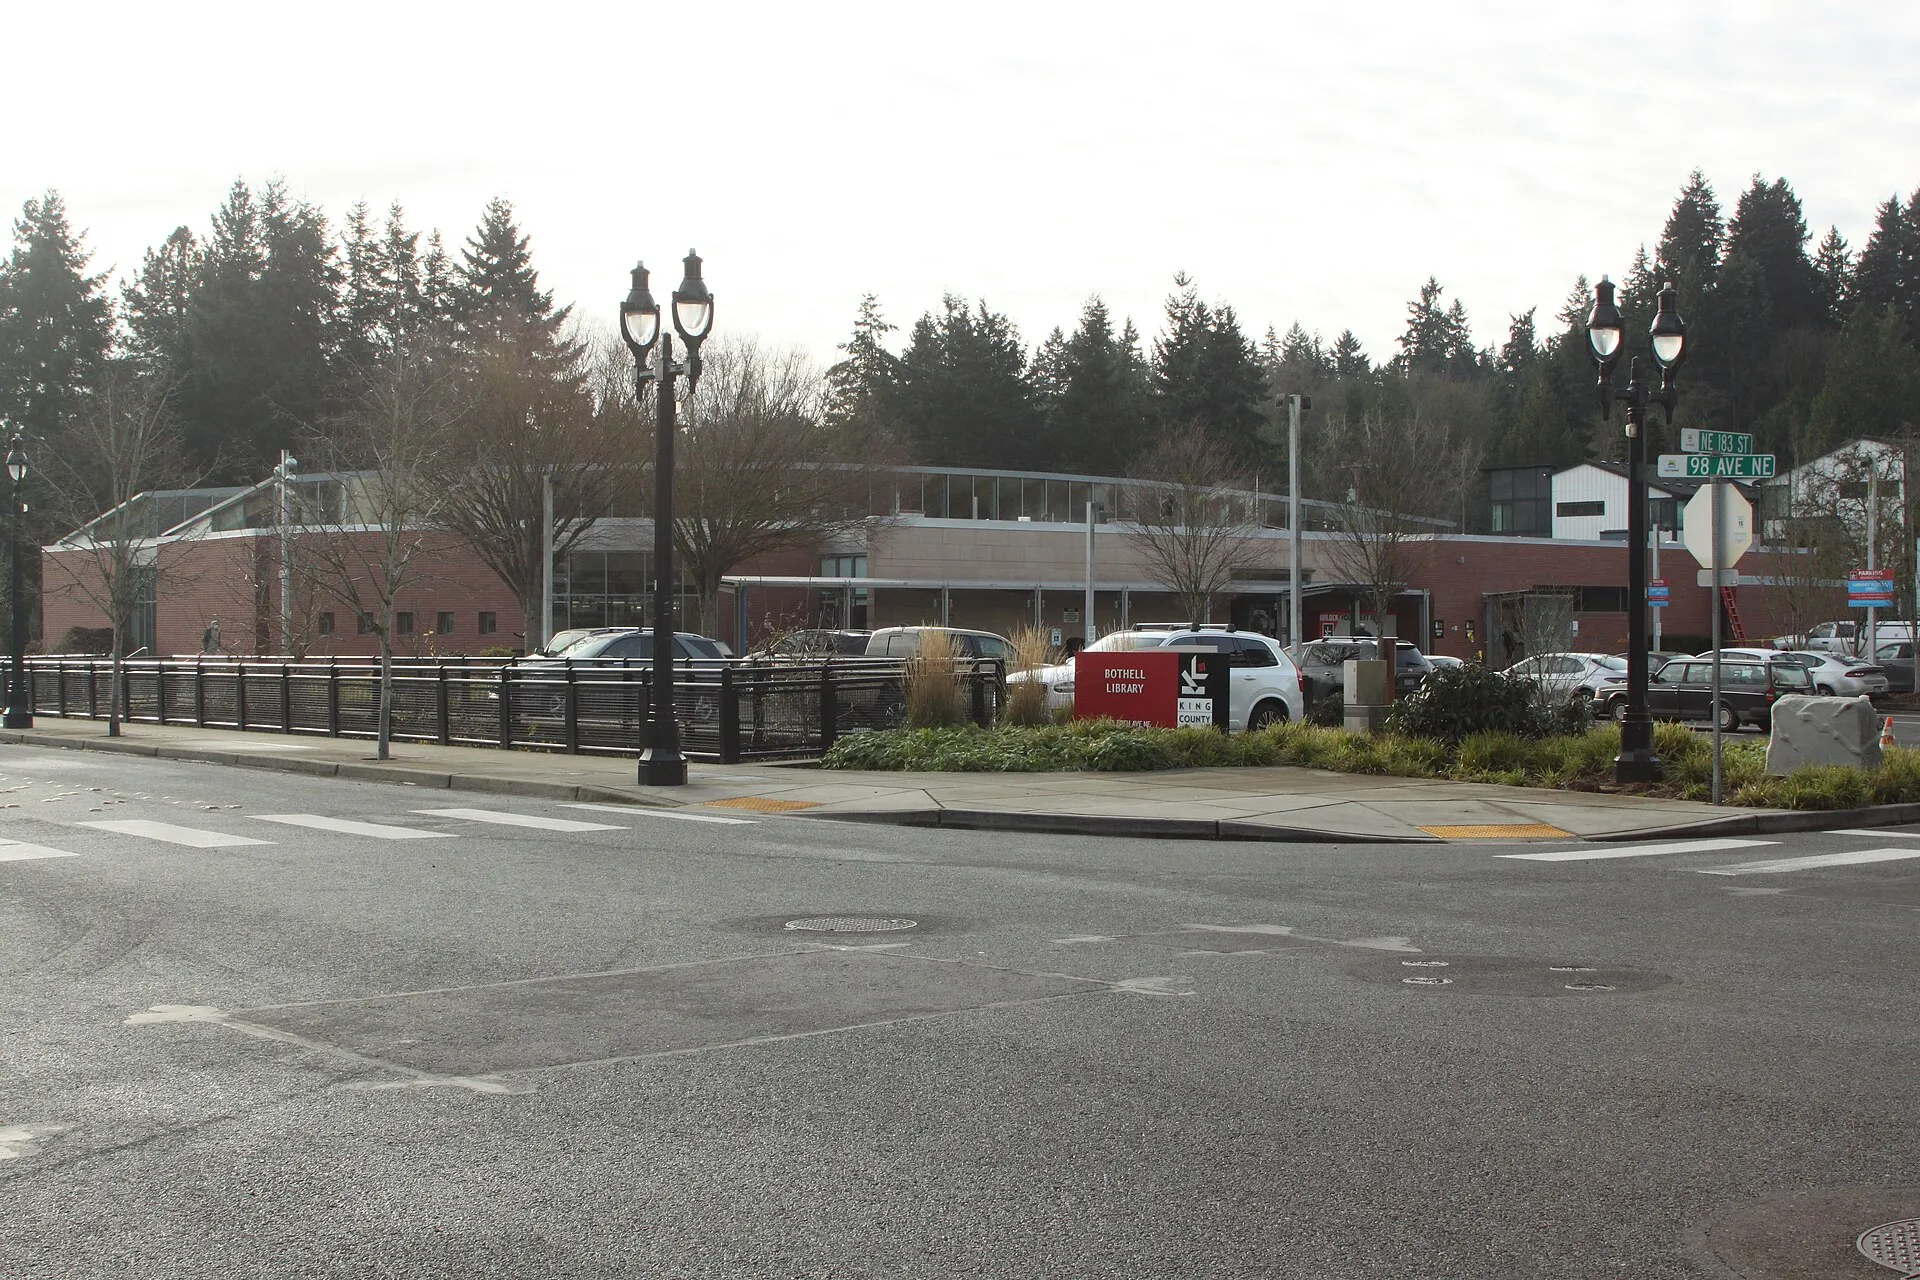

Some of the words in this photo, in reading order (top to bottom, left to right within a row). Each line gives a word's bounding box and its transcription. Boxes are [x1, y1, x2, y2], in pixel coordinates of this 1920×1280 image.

[1701, 432, 1713, 450] NE
[1718, 434, 1733, 452] 183
[1737, 436, 1749, 453] ST
[1690, 457, 1709, 475] 98
[1716, 457, 1744, 475] AVE
[1751, 457, 1772, 475] NE
[1104, 669, 1146, 680] BOTHELL
[1106, 683, 1144, 694] LIBRARY
[1179, 702, 1211, 711] KING
[1179, 715, 1210, 723] COUNTY
